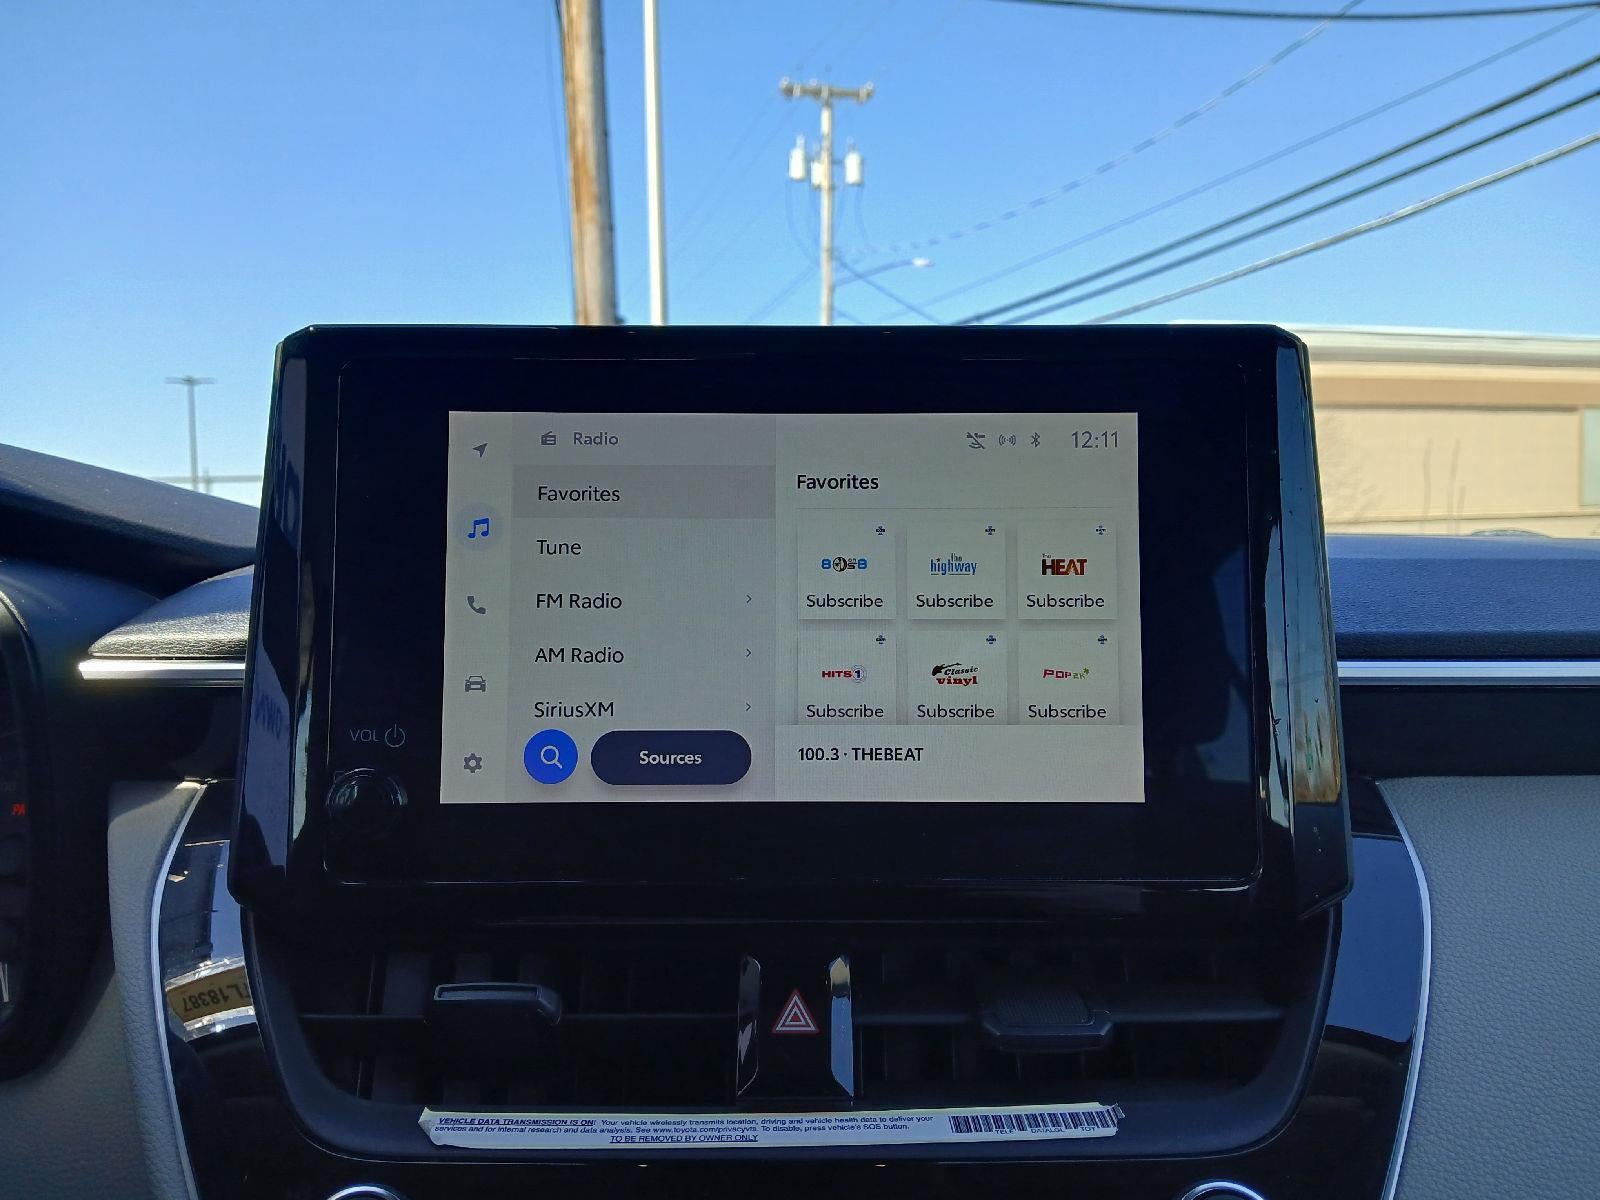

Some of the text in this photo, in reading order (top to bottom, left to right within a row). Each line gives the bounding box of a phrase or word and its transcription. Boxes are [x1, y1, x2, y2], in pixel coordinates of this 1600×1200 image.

[572, 431, 619, 447] Radio
[1071, 431, 1119, 449] 12:11
[796, 473, 879, 490] Favorites
[537, 485, 621, 502] Favorites
[536, 539, 582, 556] Tune
[930, 559, 978, 576] highway
[1041, 558, 1088, 576] HEAT
[535, 592, 623, 610] FM Radio
[806, 593, 884, 608] Subscribe
[916, 593, 994, 608] Subscribe
[1026, 593, 1105, 608] Subscribe
[534, 646, 625, 664] AM Radio
[821, 670, 852, 678] HITS
[936, 675, 978, 687] vinyl
[534, 700, 616, 718] SiriusXM
[806, 703, 885, 718] Subscribe
[917, 703, 995, 718] Subscribe
[1028, 703, 1107, 718] Subscribe
[350, 728, 380, 742] VOL
[638, 750, 703, 766] Sources
[797, 747, 924, 761] 100.3 THEBEAT
[439, 1117, 476, 1125] VEHICLE
[477, 1118, 500, 1126] DATA
[503, 1118, 565, 1126] TRANSMISSION
[649, 1118, 688, 1127] wirelessly
[689, 1118, 725, 1126] transmits
[761, 1117, 786, 1126] driving
[789, 1117, 803, 1125] and
[834, 1116, 859, 1124] health
[916, 1115, 934, 1123] your
[527, 1126, 562, 1134] research
[638, 1134, 683, 1142] REMOVED
[684, 1134, 697, 1142] BY
[734, 1133, 759, 1141] ONLY
